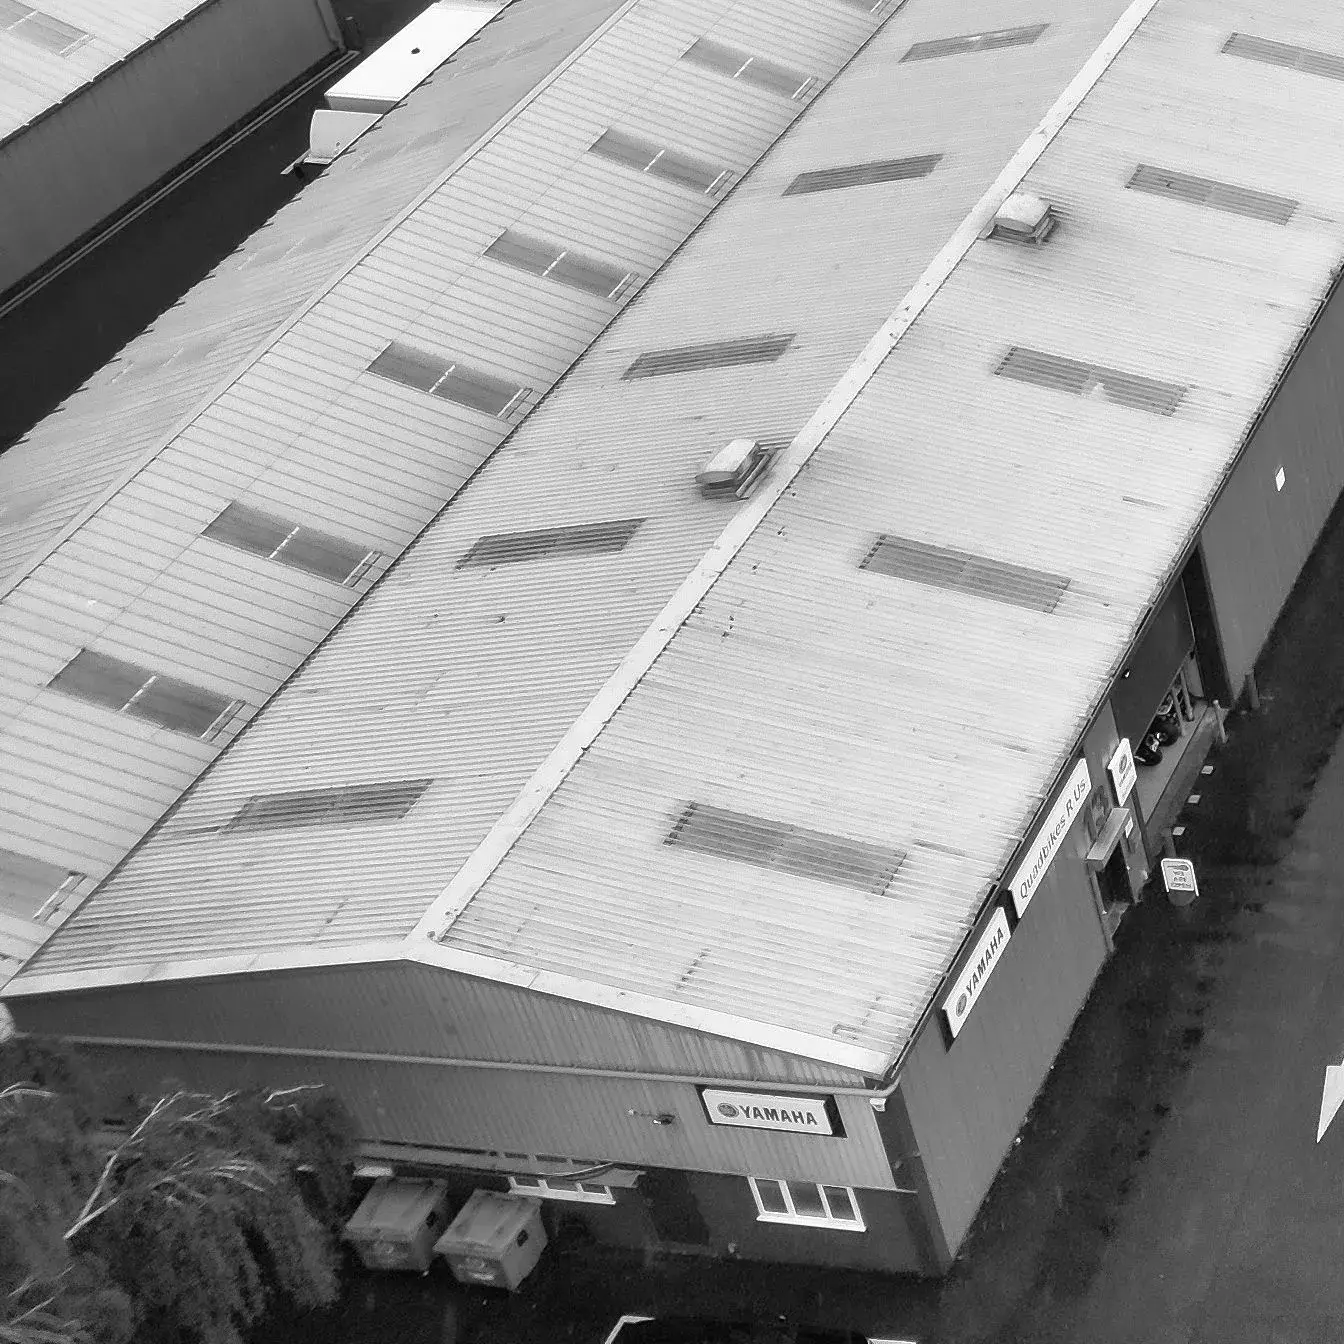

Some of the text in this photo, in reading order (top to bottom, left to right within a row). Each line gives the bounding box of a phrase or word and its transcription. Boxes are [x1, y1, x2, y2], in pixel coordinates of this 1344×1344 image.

[1019, 816, 1067, 899] Quadbikes
[1064, 799, 1074, 817] R
[966, 927, 1004, 997] YAMAHA
[738, 1105, 818, 1126] YAMAHA
